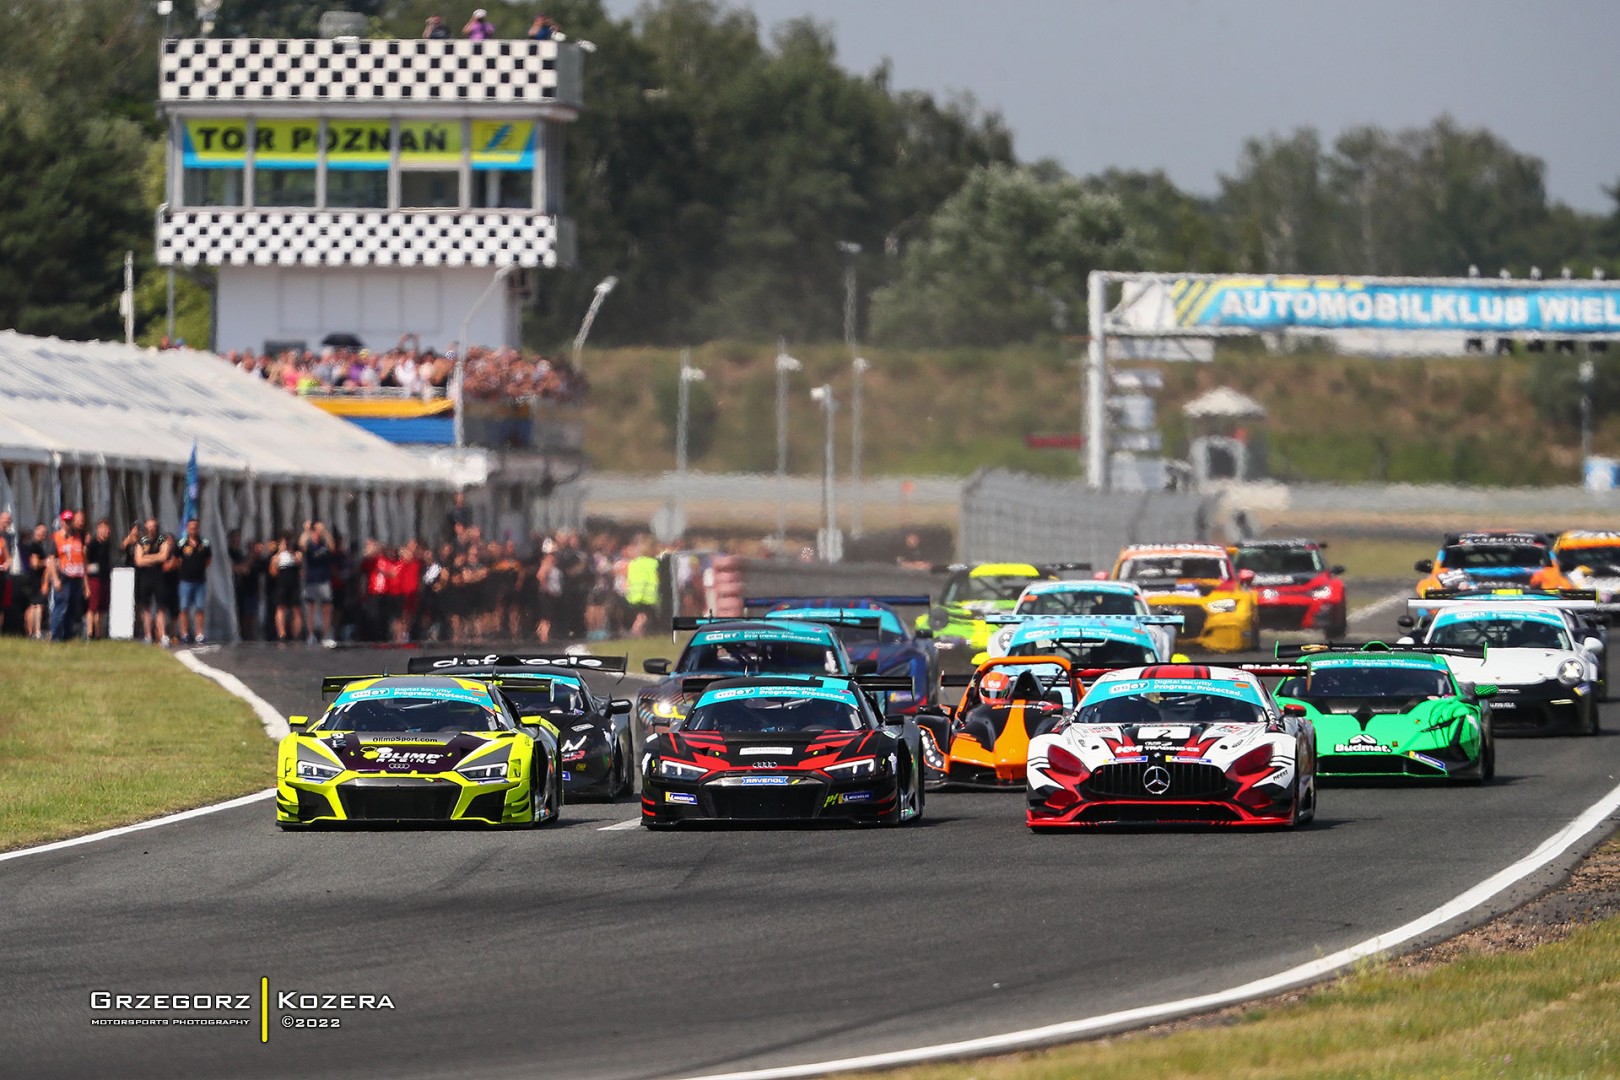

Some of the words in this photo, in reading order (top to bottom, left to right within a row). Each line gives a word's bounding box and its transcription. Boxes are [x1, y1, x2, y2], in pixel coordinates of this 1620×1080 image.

[197, 126, 277, 151] TOR
[292, 121, 447, 152] POZNAŃ
[1221, 290, 1528, 325] AUTOMOBILKLUB
[1537, 294, 1620, 326] WIEL
[1181, 679, 1213, 687] Security
[802, 690, 847, 700] Protected.
[1197, 685, 1243, 697] Protected.
[436, 692, 481, 702] Protected.
[1159, 729, 1171, 738] 2
